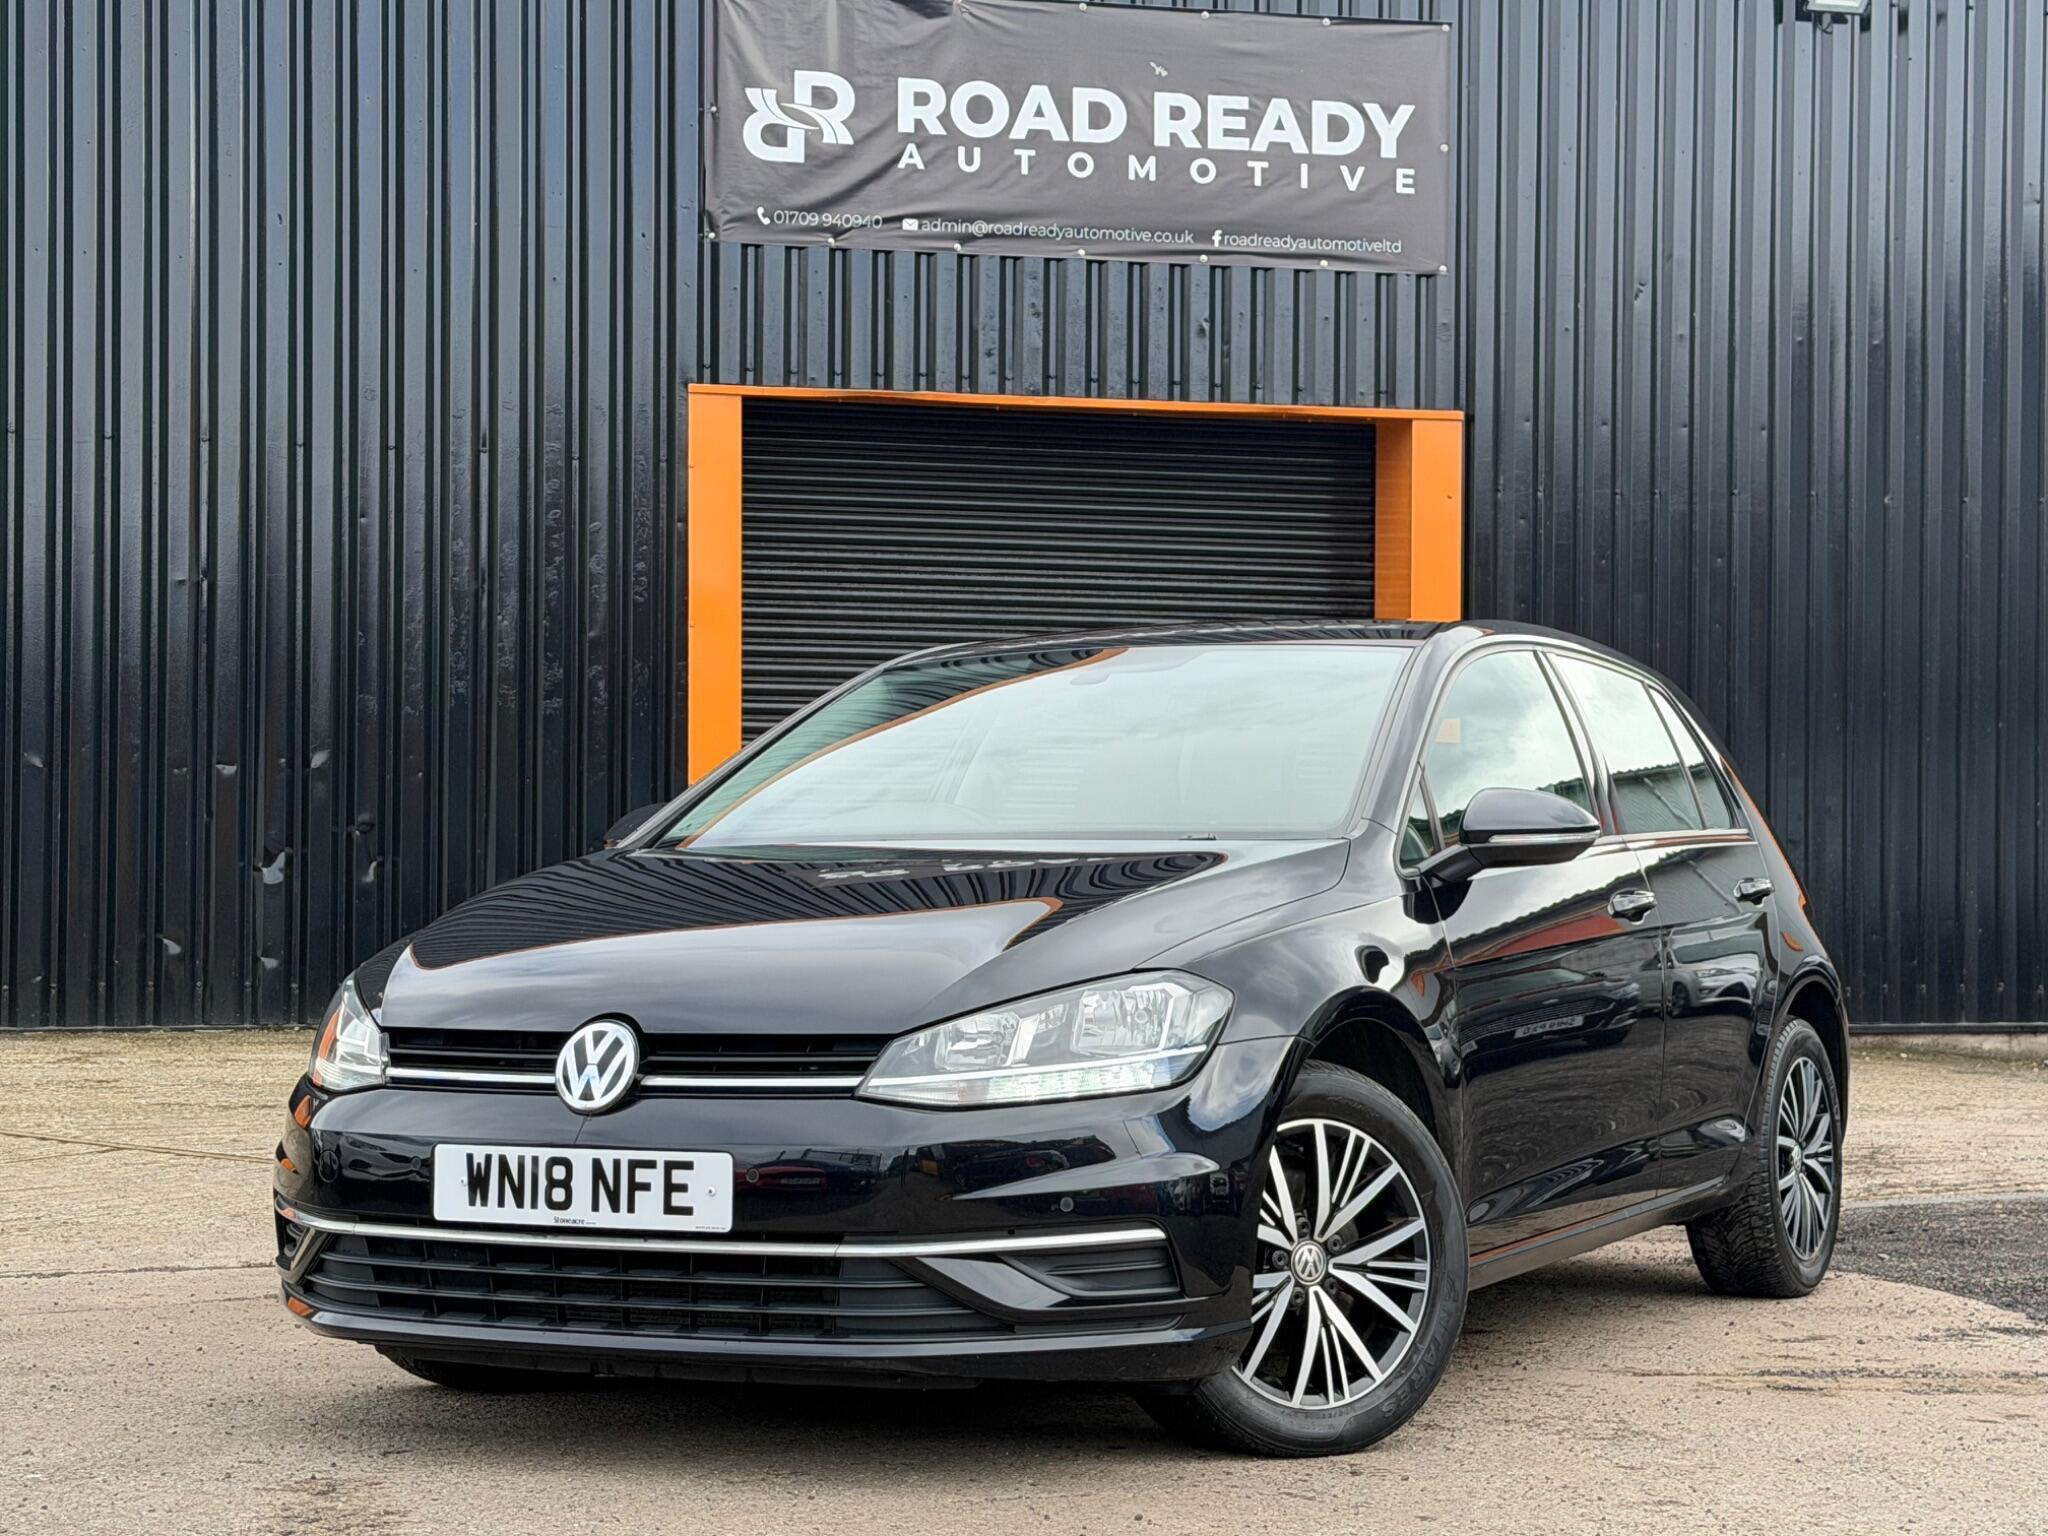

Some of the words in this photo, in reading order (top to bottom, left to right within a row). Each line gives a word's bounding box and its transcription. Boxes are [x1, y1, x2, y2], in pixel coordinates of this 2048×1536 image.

[897, 76, 1127, 143] ROAD
[1153, 92, 1416, 158] READY
[897, 144, 1416, 194] AUTOMOTIVE
[773, 209, 819, 227] 01709
[821, 211, 883, 229] 940940
[921, 218, 1194, 244] admin@roadreadyautomotive.co.uk
[1224, 232, 1402, 254] roadreadyautomotiveltd
[466, 1153, 573, 1211] WN18
[591, 1158, 695, 1216] NFE
